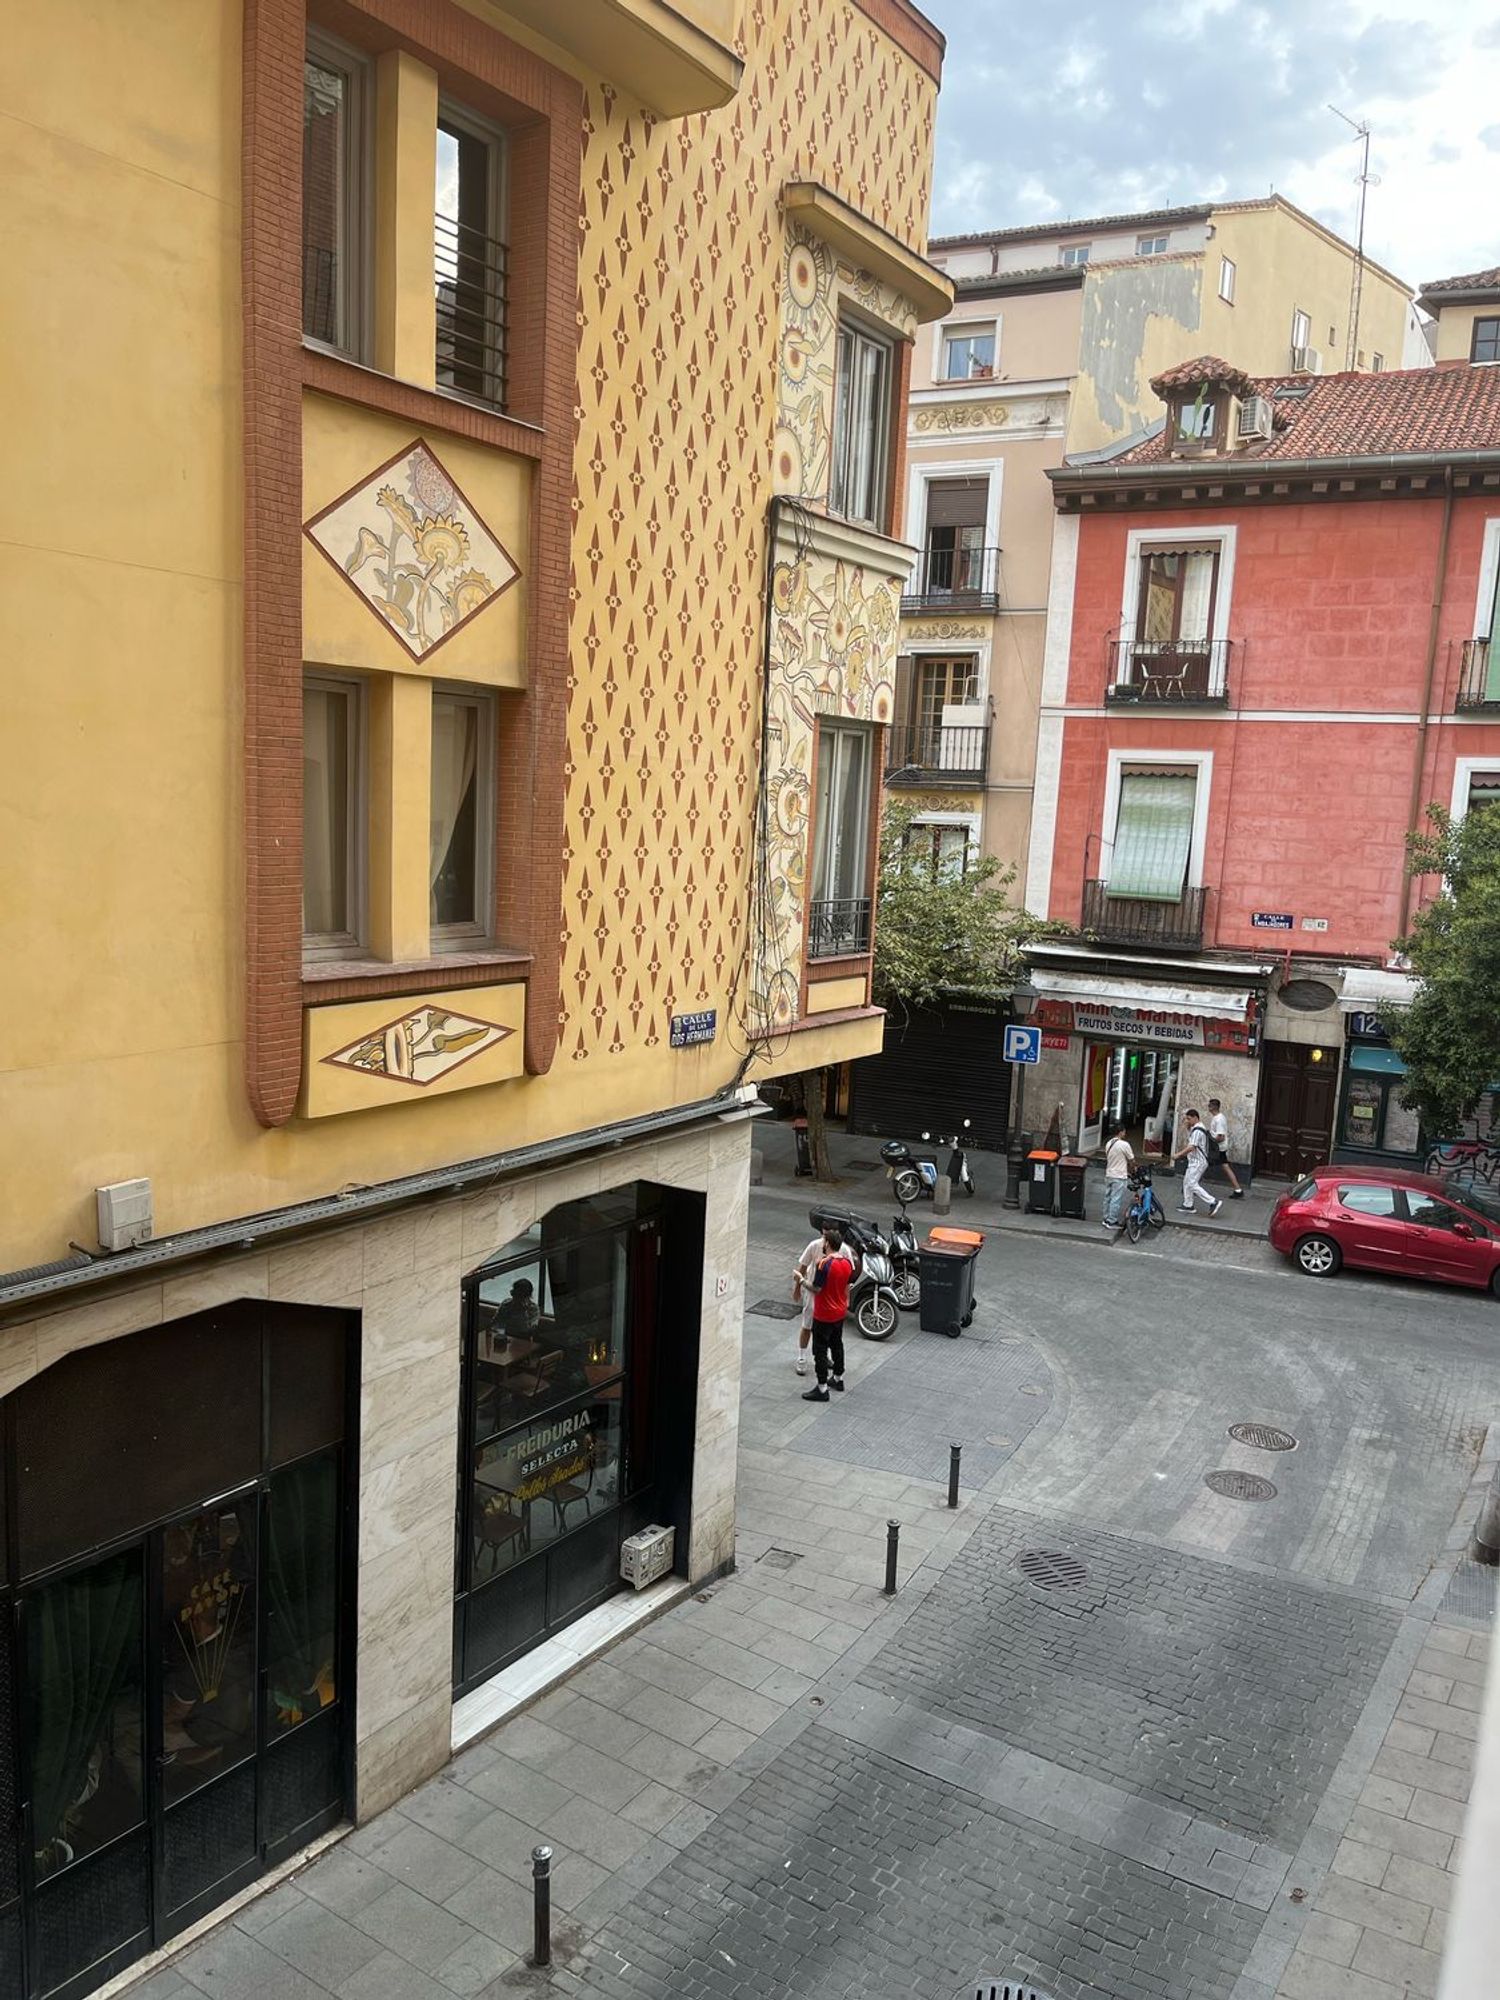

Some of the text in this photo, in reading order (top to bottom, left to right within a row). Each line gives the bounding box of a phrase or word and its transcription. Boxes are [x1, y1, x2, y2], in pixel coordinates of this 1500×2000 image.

[682, 1013, 713, 1026] CALLE
[1078, 1017, 1194, 1040] FRUTOS SECOS Y BEBIDAS
[671, 1033, 686, 1046] DOS
[1010, 1031, 1031, 1058] P
[502, 1408, 592, 1463] FREIDURIA
[520, 1438, 579, 1476] SELECTA
